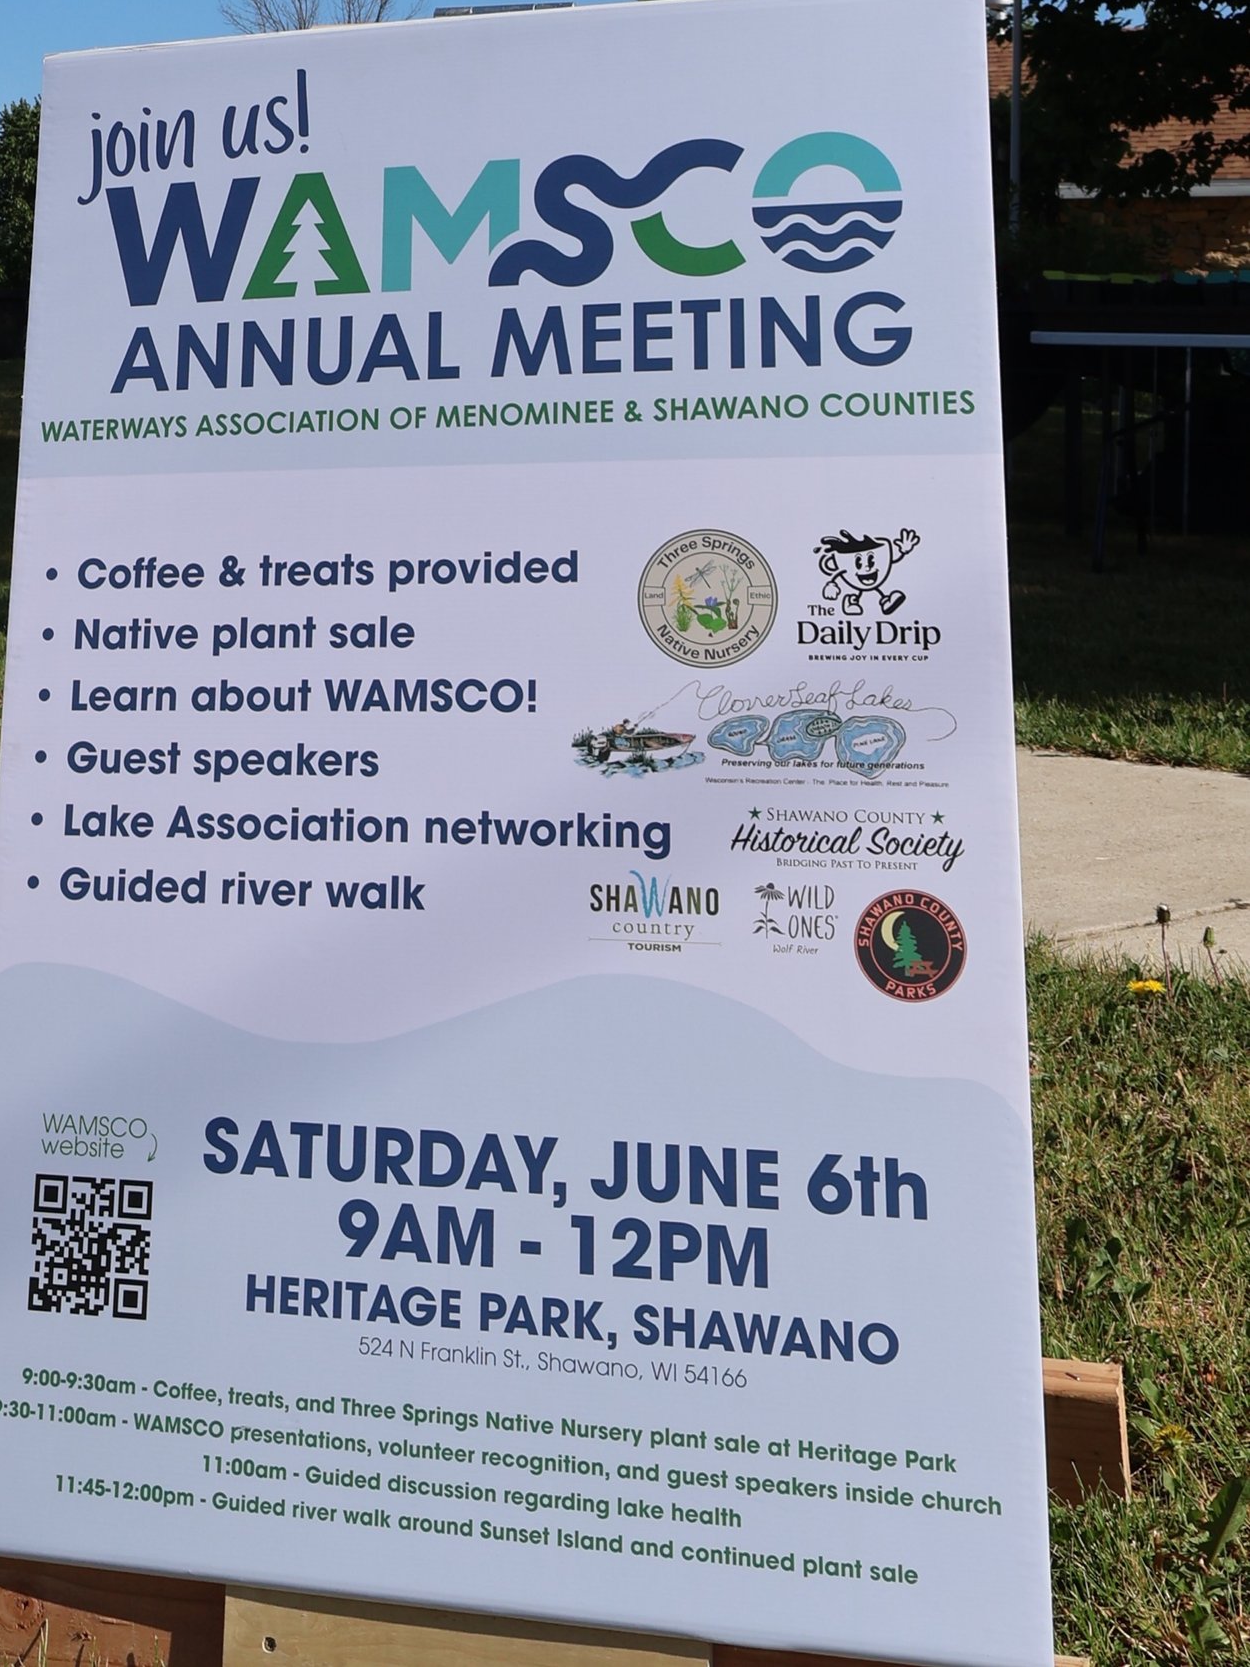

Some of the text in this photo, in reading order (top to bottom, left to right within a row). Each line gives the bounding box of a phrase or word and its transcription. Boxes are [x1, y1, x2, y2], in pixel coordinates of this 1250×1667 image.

[77, 68, 310, 205] join us!
[105, 131, 903, 307] WAMSCO
[109, 290, 913, 395] ANNUAL MEETING
[41, 389, 976, 443] WATERWAYS ASSOCIATION OF MENOMINEE & SHAWANO COUNTIES
[77, 549, 579, 593] Coffee & treats provided
[657, 536, 755, 570] Three Springs
[807, 604, 836, 616] The
[74, 615, 416, 657] Native plant sale
[657, 624, 760, 660] Native Nursery
[797, 620, 941, 651] Daily Drip
[849, 654, 867, 662] JOY
[881, 654, 909, 662] EVERY
[911, 654, 929, 662] CUP
[71, 678, 537, 714] Learn about WAMSCO!
[66, 740, 380, 783] Guest speakers
[721, 759, 772, 768] Preserving
[793, 759, 817, 767] lakes
[820, 760, 834, 769] for
[837, 761, 865, 769] future
[867, 762, 925, 770] generations
[63, 803, 671, 861] Lake Association networking
[766, 807, 926, 825] SHAWANO COUNTY
[731, 822, 964, 872] Historical Society
[776, 858, 918, 871] BRIDGING PAST TO PRESENT
[59, 866, 426, 911] Guided river walk
[590, 870, 720, 919] SHAWANO
[788, 884, 835, 909] WILD
[612, 921, 695, 940] country
[788, 915, 835, 940] ONES
[858, 894, 963, 951] SHAWANO COUNTY
[627, 942, 682, 953] TOURISM
[773, 944, 818, 954] Wolf River
[885, 981, 936, 998] PARKS
[41, 1136, 124, 1158] website
[43, 1113, 147, 1139] WAMSCO
[202, 1116, 929, 1221] SATURDAY, JUNE 6th
[338, 1198, 769, 1289] 9AM - 12PM
[245, 1273, 900, 1366] HERITAGE PARK, SHAWANO
[358, 1337, 748, 1389] 524 N Franklin St., Shawano, WI 54166
[22, 1367, 136, 1395] 9:00-9:30am
[152, 1379, 223, 1407] Coffee,
[227, 1386, 290, 1414] treats,
[295, 1396, 336, 1415] and
[340, 1397, 397, 1420] Three
[402, 1402, 479, 1432] Springs
[485, 1410, 555, 1435] Native
[561, 1417, 644, 1448] Nursery
[650, 1427, 708, 1450] plant
[713, 1434, 761, 1455] sale
[767, 1438, 791, 1458] at
[798, 1439, 898, 1472] Heritage
[905, 1449, 957, 1474] Park
[133, 1412, 225, 1439] WAMSCO
[230, 1425, 372, 1458] presentations,
[377, 1438, 476, 1464] volunteer
[481, 1451, 611, 1481] recognition,
[616, 1463, 660, 1483] and
[666, 1468, 729, 1490] guest
[734, 1475, 838, 1500] speakers
[845, 1481, 915, 1507] inside
[921, 1490, 1002, 1516] church
[202, 1454, 287, 1481] 11:00am
[305, 1465, 381, 1491] Guided
[387, 1474, 497, 1503] discussion
[503, 1489, 610, 1520] regarding
[617, 1496, 665, 1520] lake
[671, 1502, 742, 1528] health
[55, 1474, 195, 1508] 11:45-12:00pm
[211, 1491, 286, 1517] Guided
[292, 1500, 338, 1523] river
[342, 1508, 392, 1529] walk
[397, 1515, 474, 1538] around
[479, 1519, 551, 1546] Sunset
[557, 1528, 623, 1554] Island
[630, 1539, 674, 1559] and
[681, 1545, 795, 1572] continued
[802, 1555, 863, 1579] plant
[869, 1563, 919, 1585] sale
